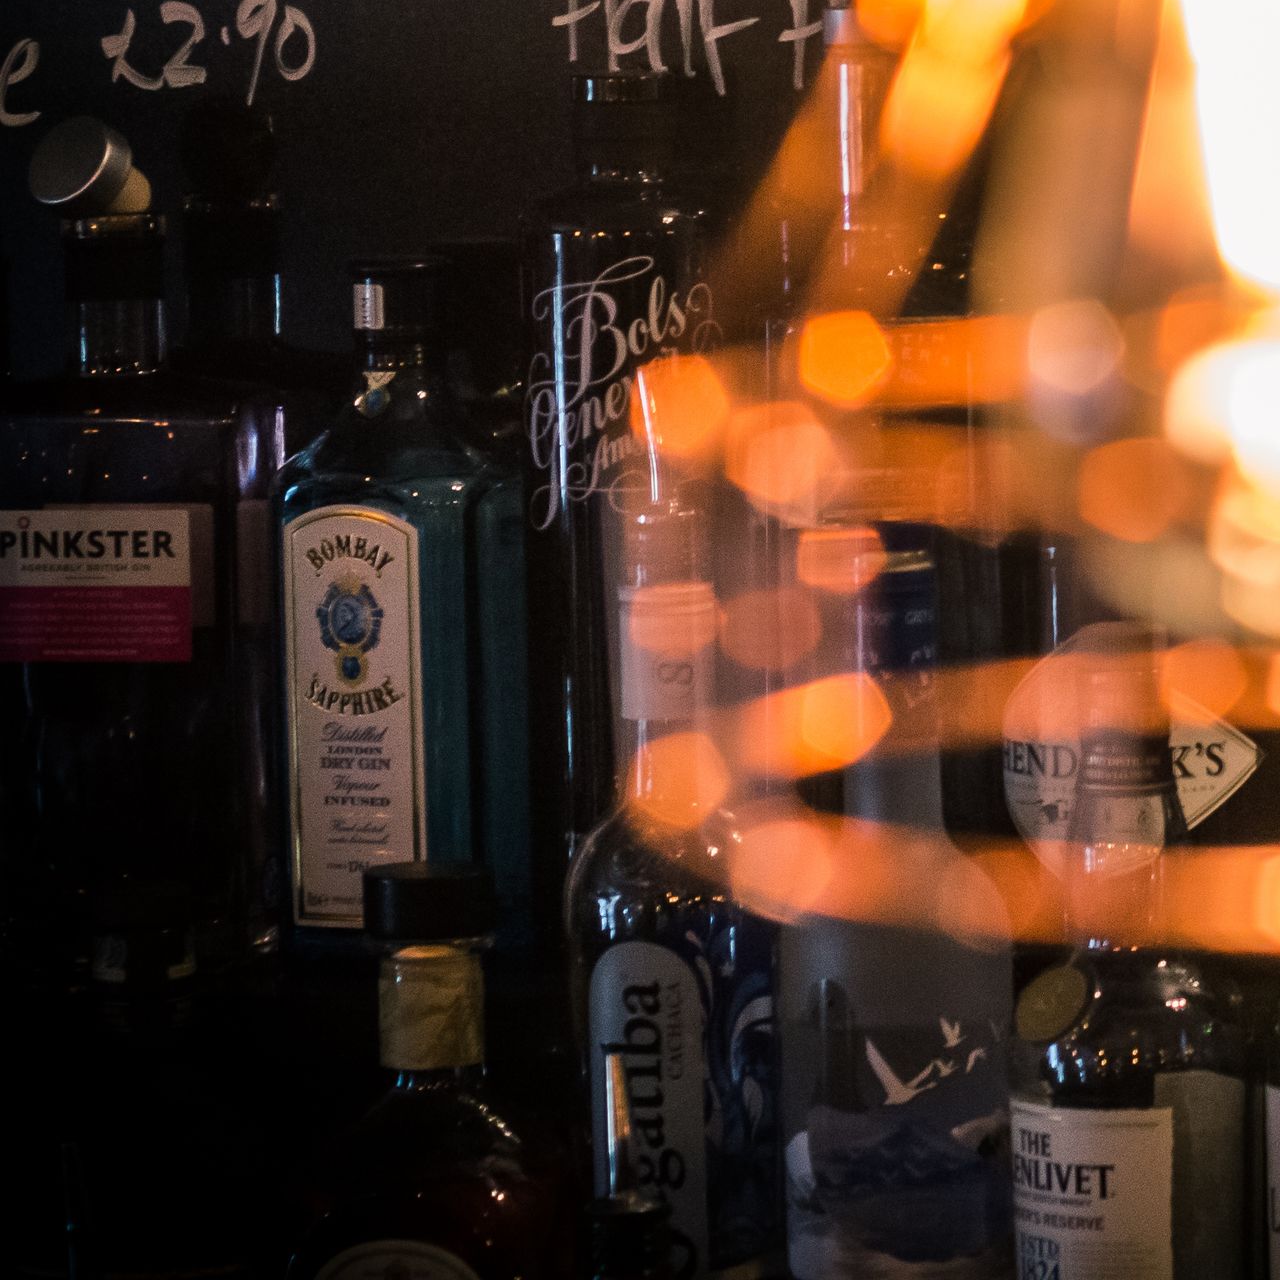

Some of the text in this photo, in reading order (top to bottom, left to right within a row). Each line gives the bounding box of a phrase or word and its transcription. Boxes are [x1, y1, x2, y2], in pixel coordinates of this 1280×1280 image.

[0, 530, 176, 559] PINKSTER
[305, 534, 395, 573] BOMBAY
[303, 674, 404, 716] SAPPHIRE
[320, 757, 391, 771] DRY GIN
[324, 794, 391, 807] INFUSED
[1020, 1128, 1051, 1158] THE
[1013, 1152, 1116, 1200] ENLIVET
